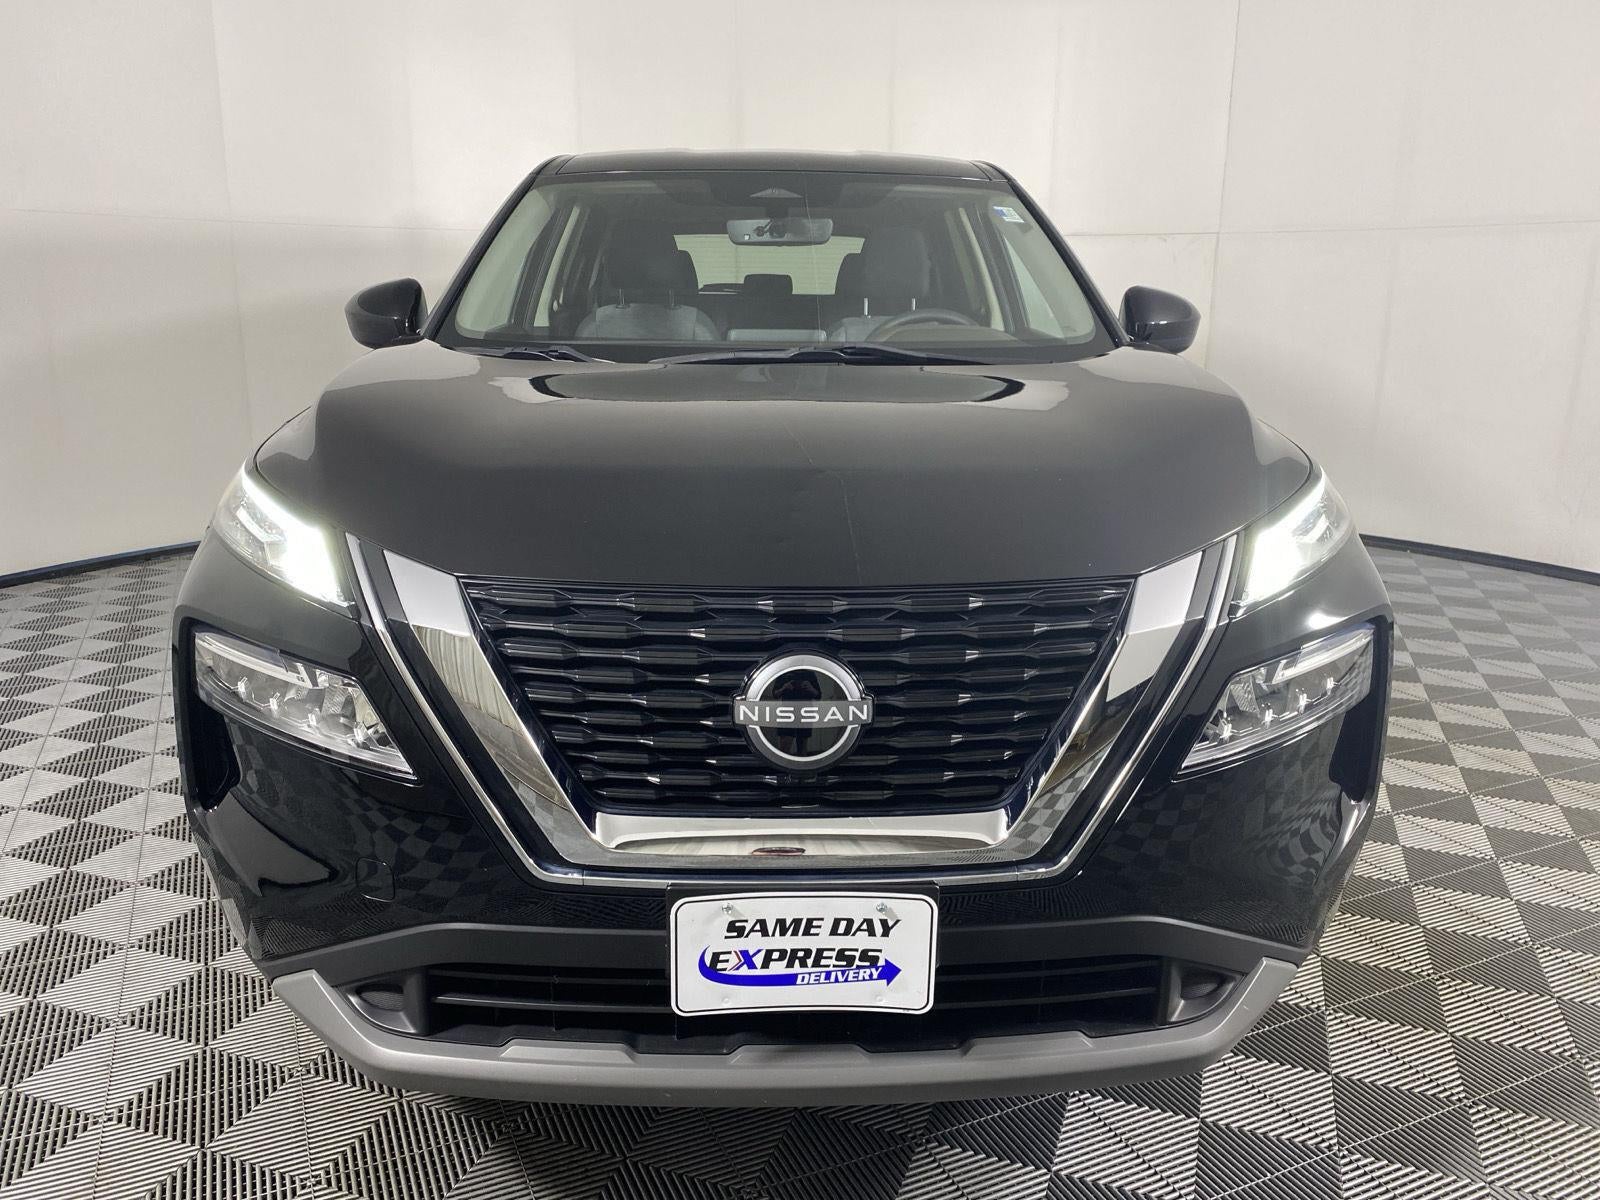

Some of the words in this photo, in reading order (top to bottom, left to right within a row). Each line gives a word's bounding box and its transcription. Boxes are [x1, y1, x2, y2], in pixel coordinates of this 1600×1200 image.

[739, 705, 868, 722] NISSAN
[724, 917, 823, 939] SAME
[829, 917, 901, 938] DAY
[708, 948, 883, 971] EXPRESS
[796, 967, 883, 985] DELIVERY
